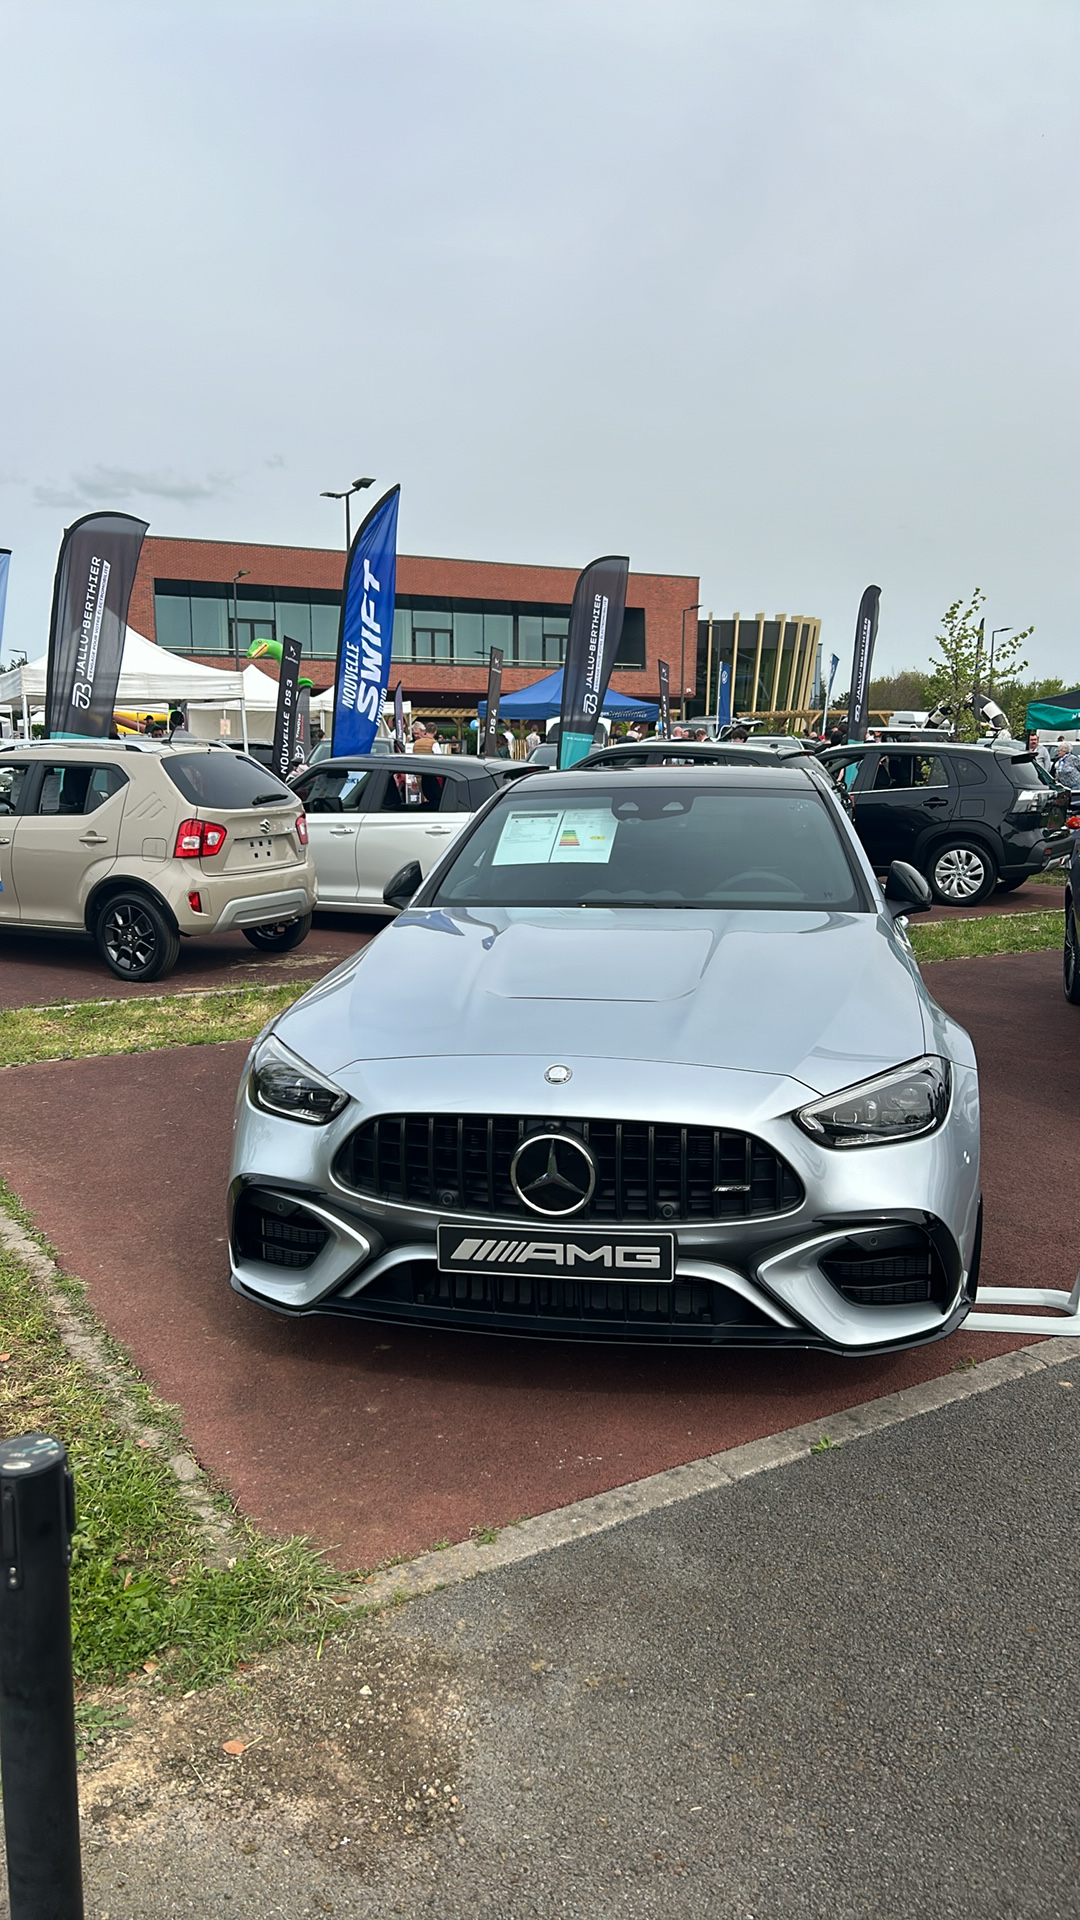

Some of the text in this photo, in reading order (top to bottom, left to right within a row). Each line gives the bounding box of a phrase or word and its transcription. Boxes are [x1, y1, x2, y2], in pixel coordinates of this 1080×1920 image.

[76, 555, 101, 676] JALLU-BERTHIER
[356, 558, 382, 723] SWIFT
[586, 593, 602, 689] JALLU-BERTHIER
[342, 641, 359, 709] NOUVELLE
[280, 679, 293, 774] NOUVELLE DS 3
